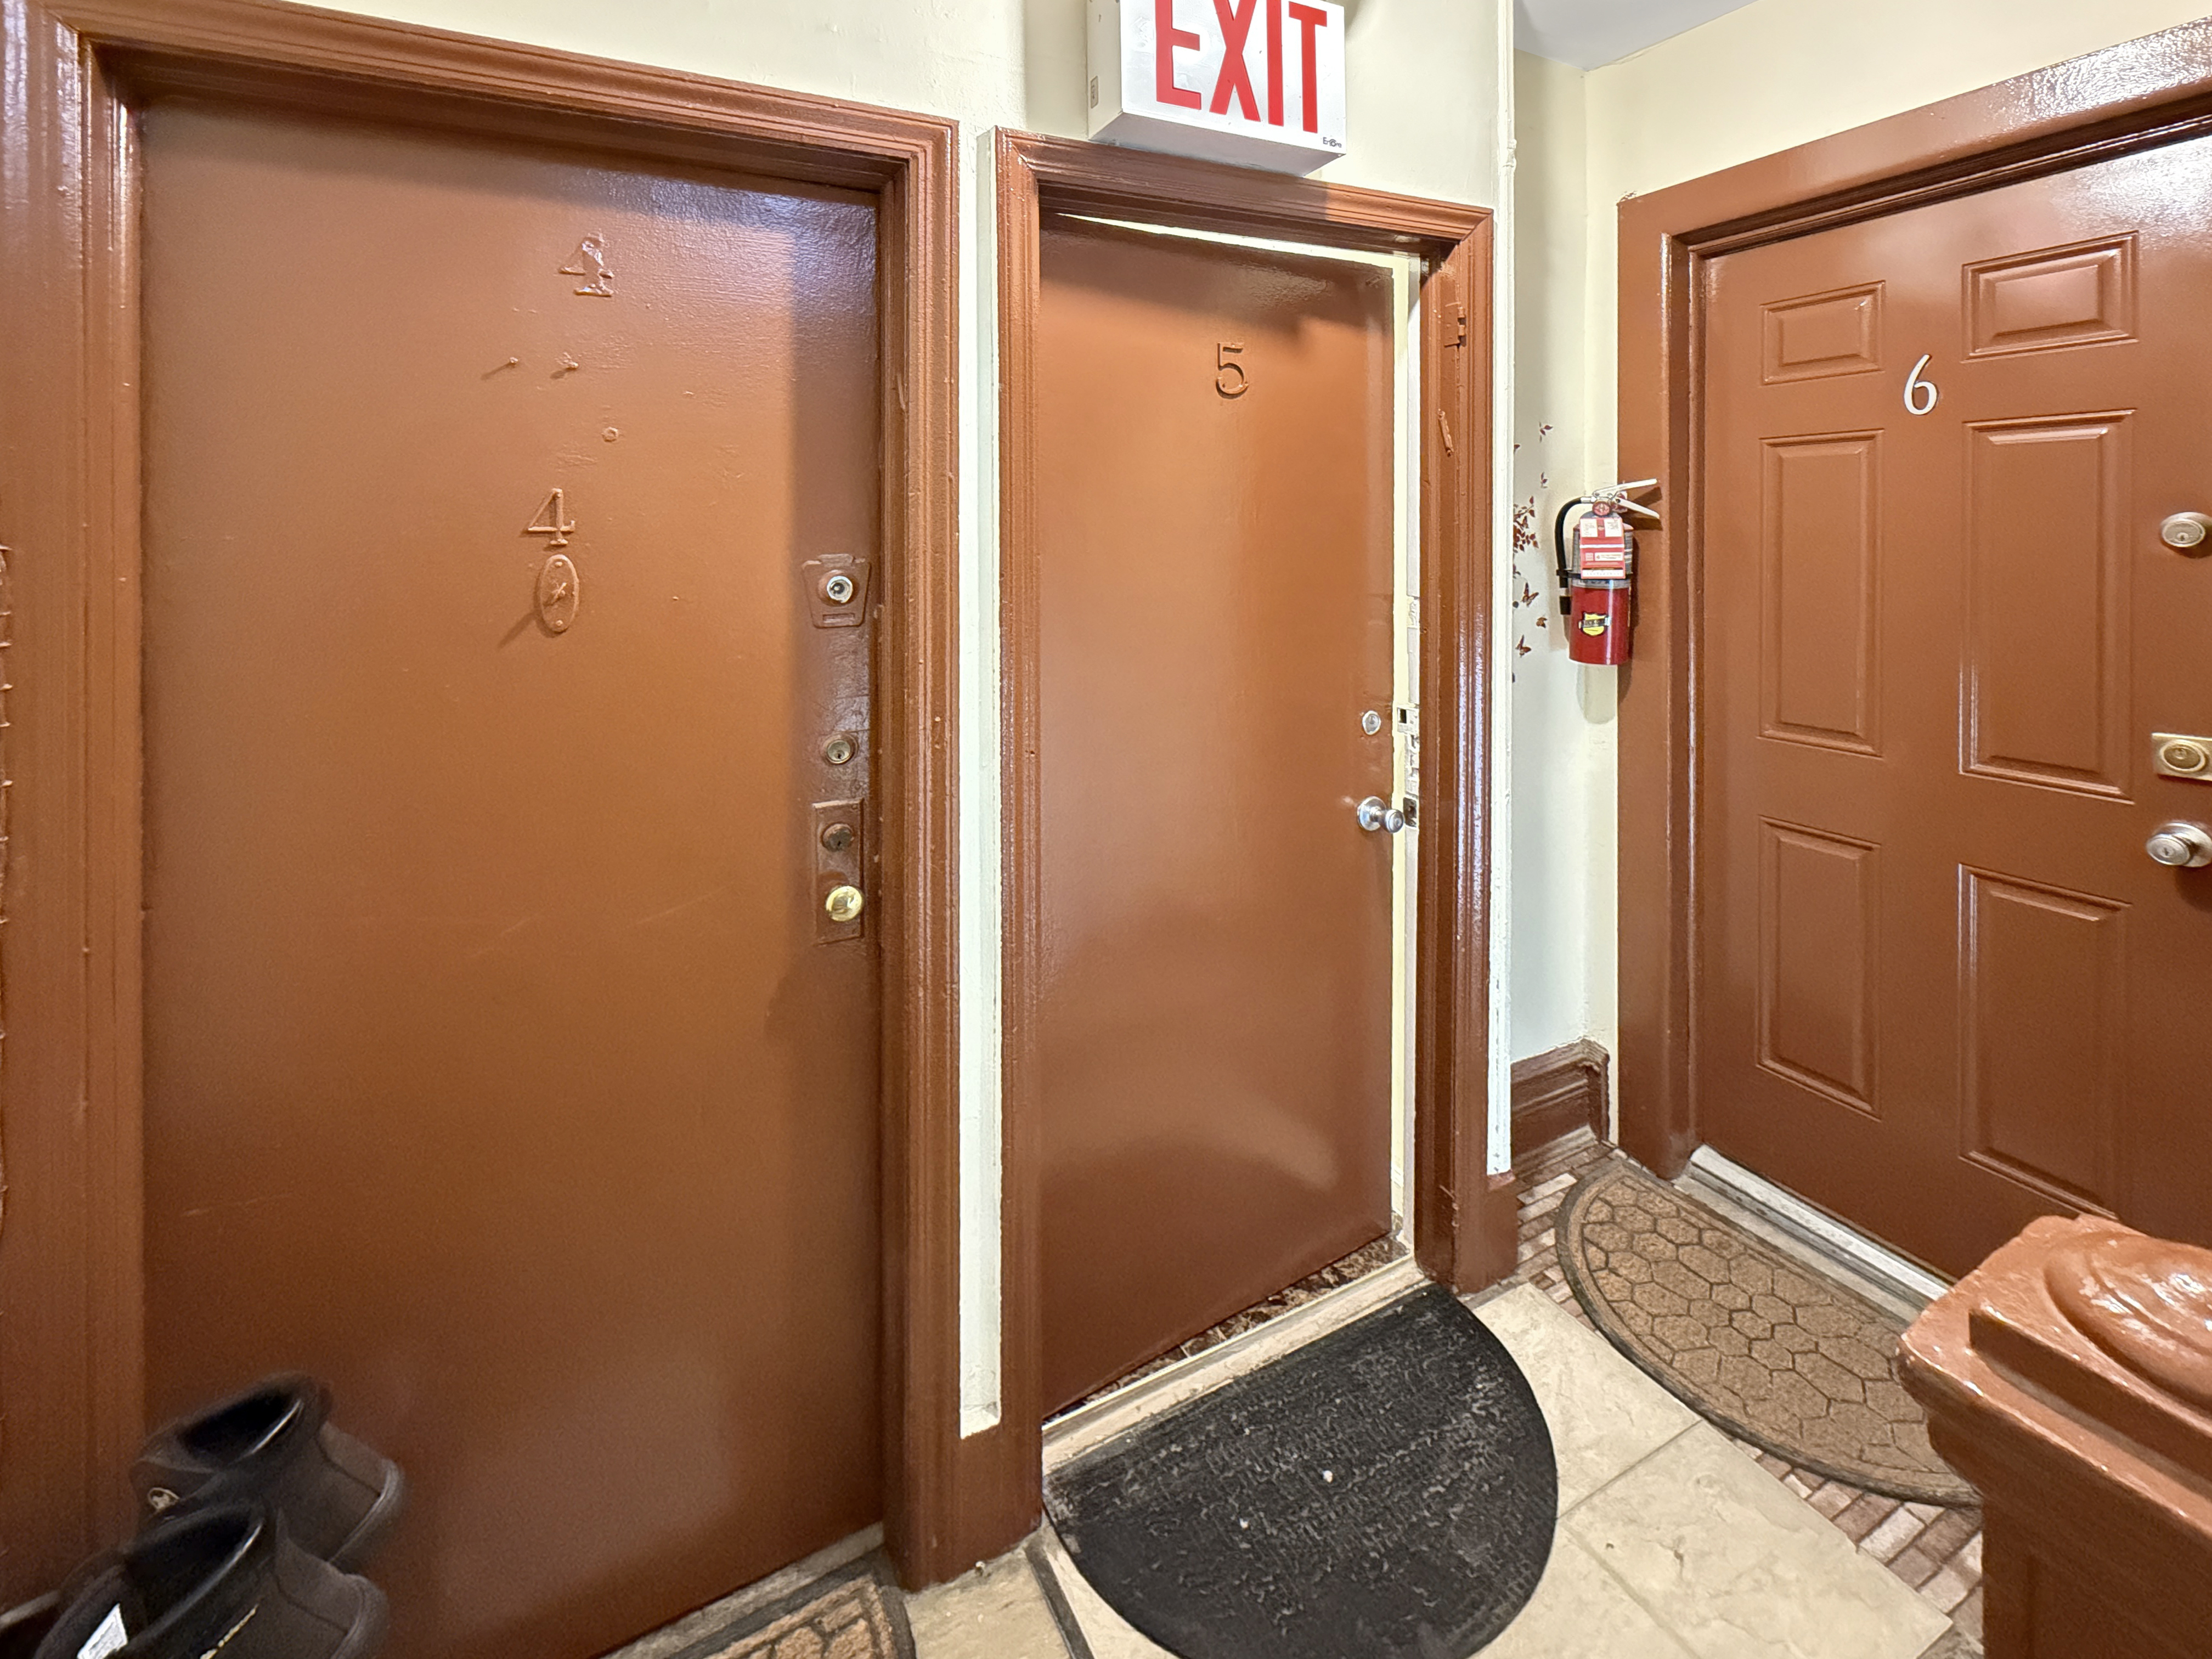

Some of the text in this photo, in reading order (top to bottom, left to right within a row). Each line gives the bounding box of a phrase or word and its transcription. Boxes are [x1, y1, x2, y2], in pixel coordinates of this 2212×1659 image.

[1156, 0, 1328, 133] EXIT
[1215, 341, 1249, 399] 5
[1904, 354, 1938, 415] 6
[527, 488, 575, 546] 4
